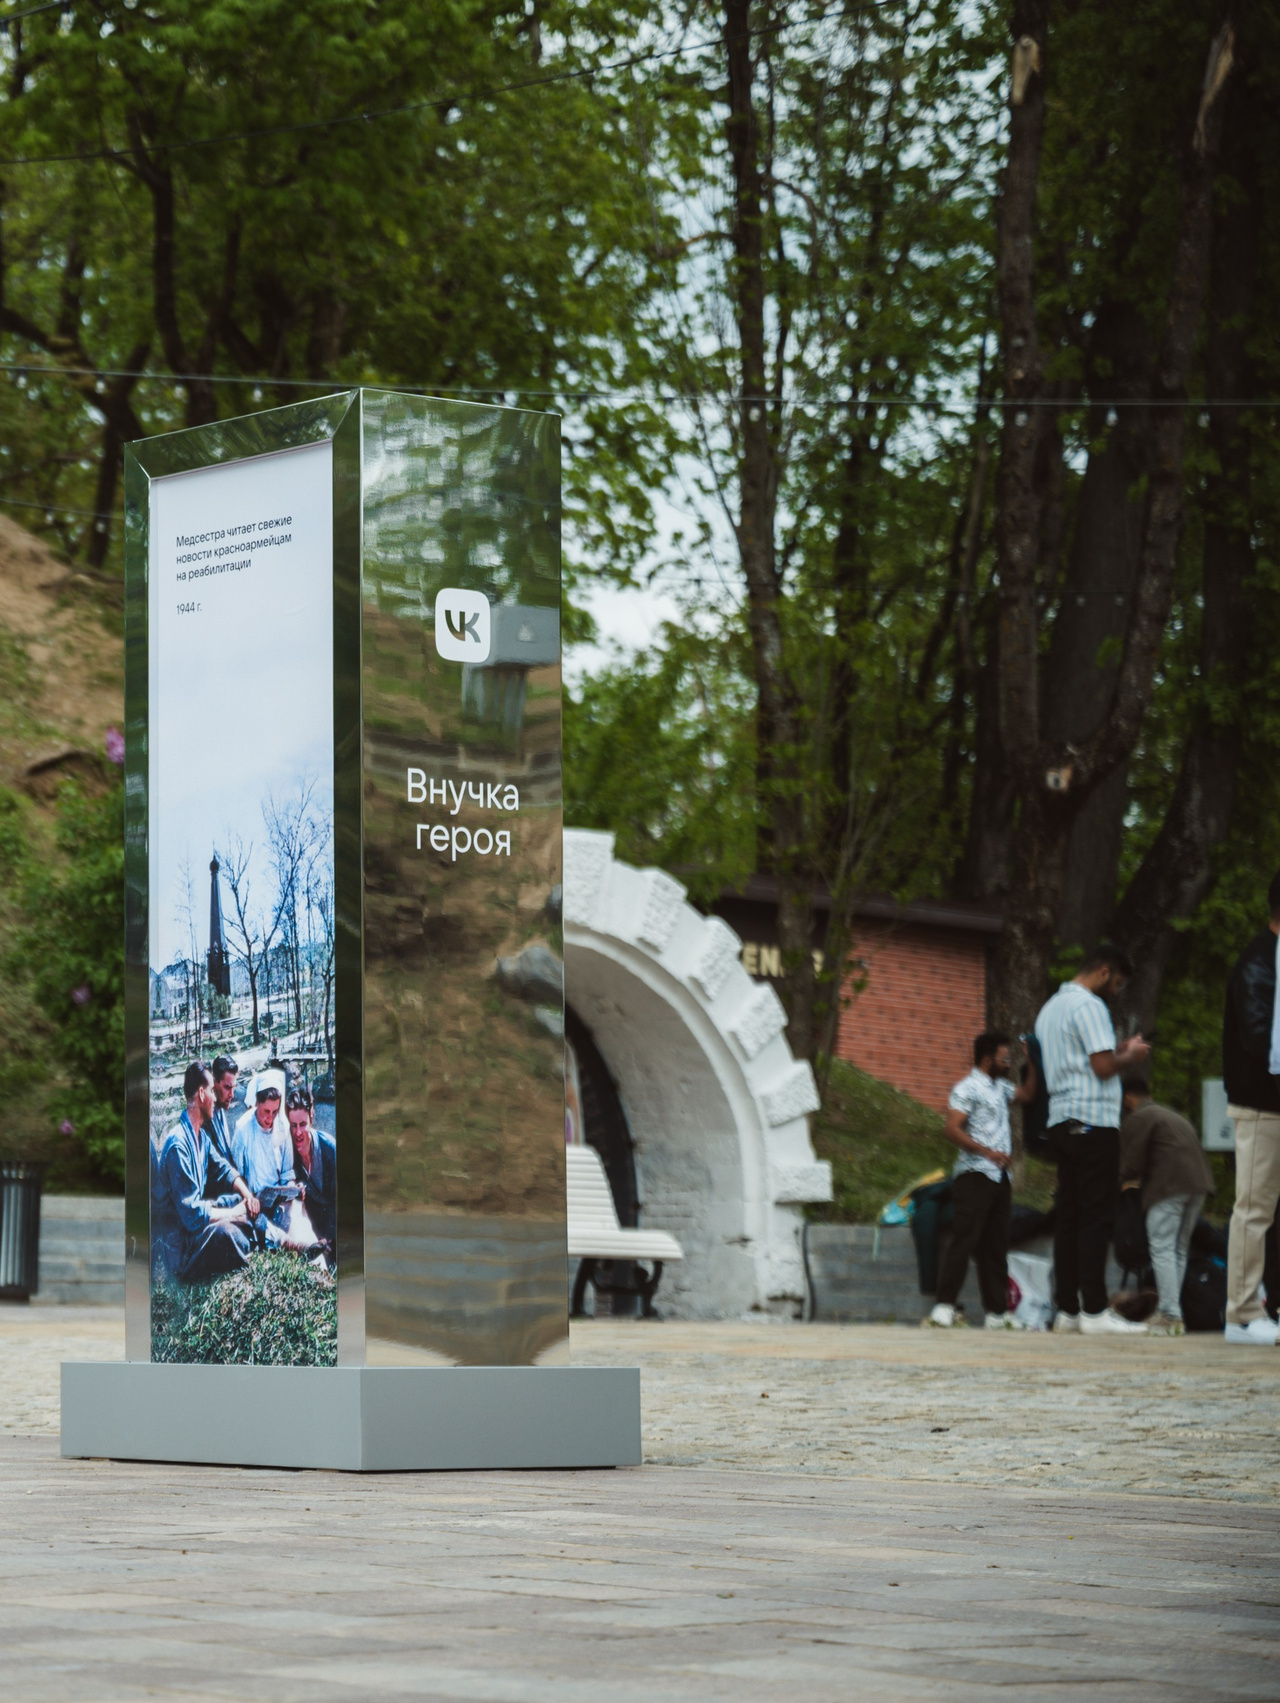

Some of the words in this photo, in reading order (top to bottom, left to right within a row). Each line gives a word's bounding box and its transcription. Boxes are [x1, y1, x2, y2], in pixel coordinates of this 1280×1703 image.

[176, 529, 225, 547] Медсестра
[227, 523, 256, 537] читает
[258, 515, 292, 530] свежие
[176, 549, 212, 564] новости
[214, 534, 292, 558] красноармейцам
[176, 570, 187, 581] на
[189, 559, 252, 581] реабилитации
[176, 602, 195, 615] 1944
[197, 602, 202, 612] г.
[407, 767, 519, 815] Внучка
[416, 824, 511, 861] героя
